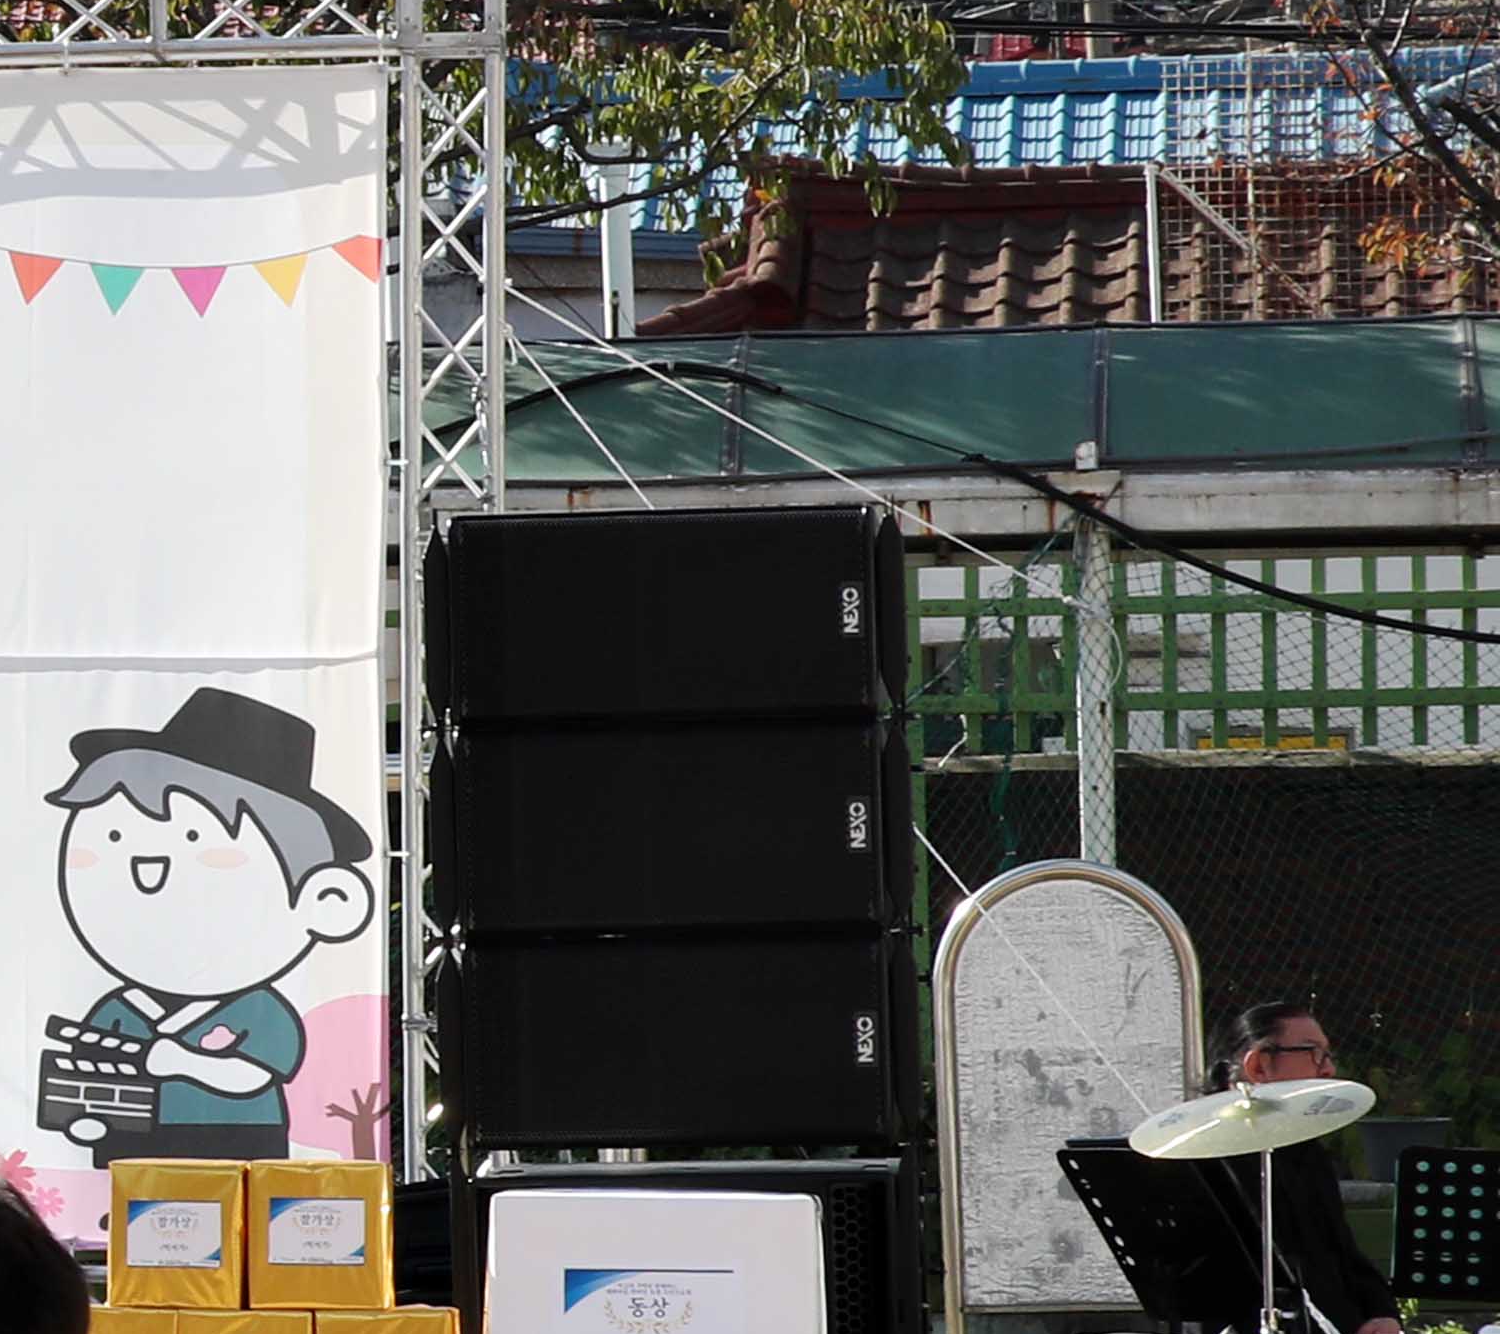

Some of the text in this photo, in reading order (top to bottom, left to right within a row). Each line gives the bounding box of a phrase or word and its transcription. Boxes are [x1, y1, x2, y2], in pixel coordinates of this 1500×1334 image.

[843, 586, 859, 634] NEXO
[850, 801, 866, 849] NEXO
[857, 1016, 874, 1064] NEXO
[628, 1297, 670, 1318] 동상
